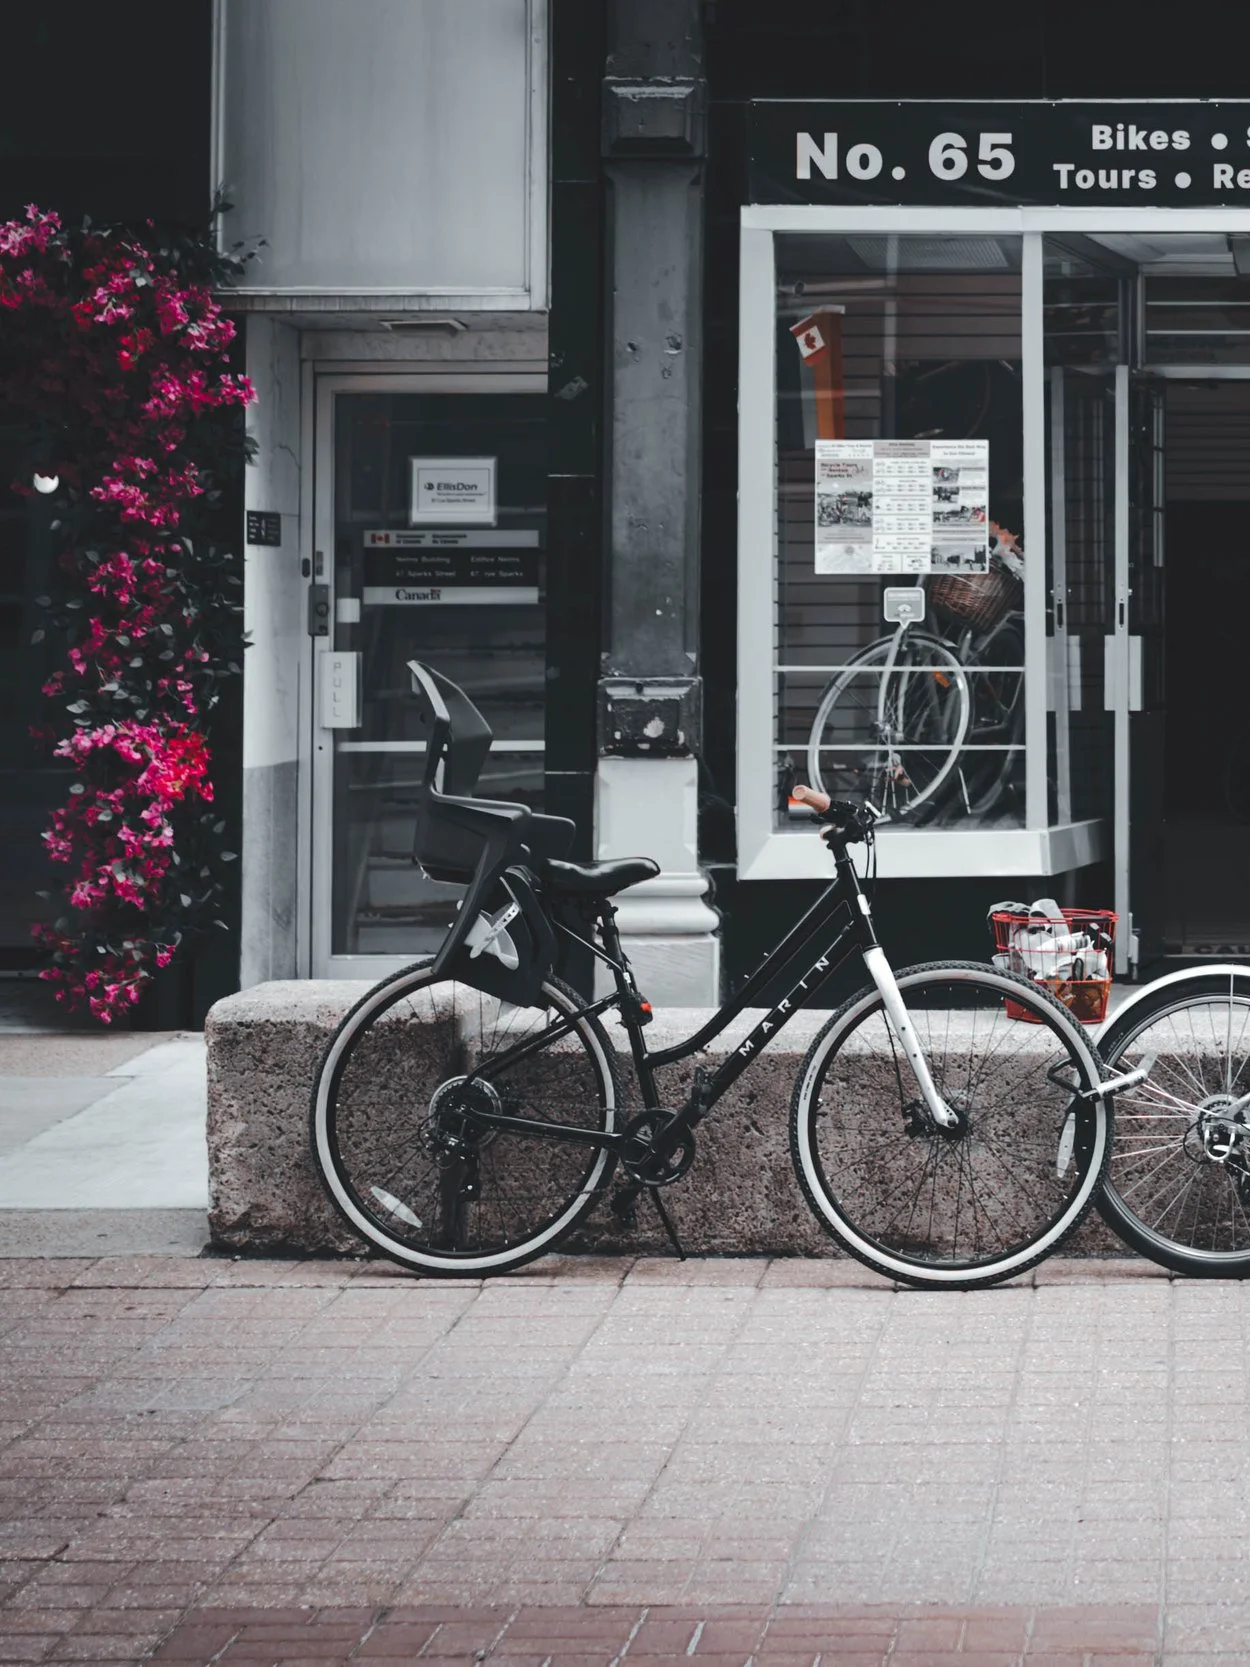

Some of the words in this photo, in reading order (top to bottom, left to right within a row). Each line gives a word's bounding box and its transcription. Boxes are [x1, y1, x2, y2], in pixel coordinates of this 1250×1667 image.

[1091, 122, 1191, 151] Bikes
[796, 132, 906, 181] No.
[928, 132, 1016, 181] 65
[1052, 163, 1157, 190] Tours
[437, 482, 478, 491] EllisDon
[395, 589, 442, 601] Canada
[332, 661, 342, 718] PULL
[738, 956, 830, 1057] MARIN
